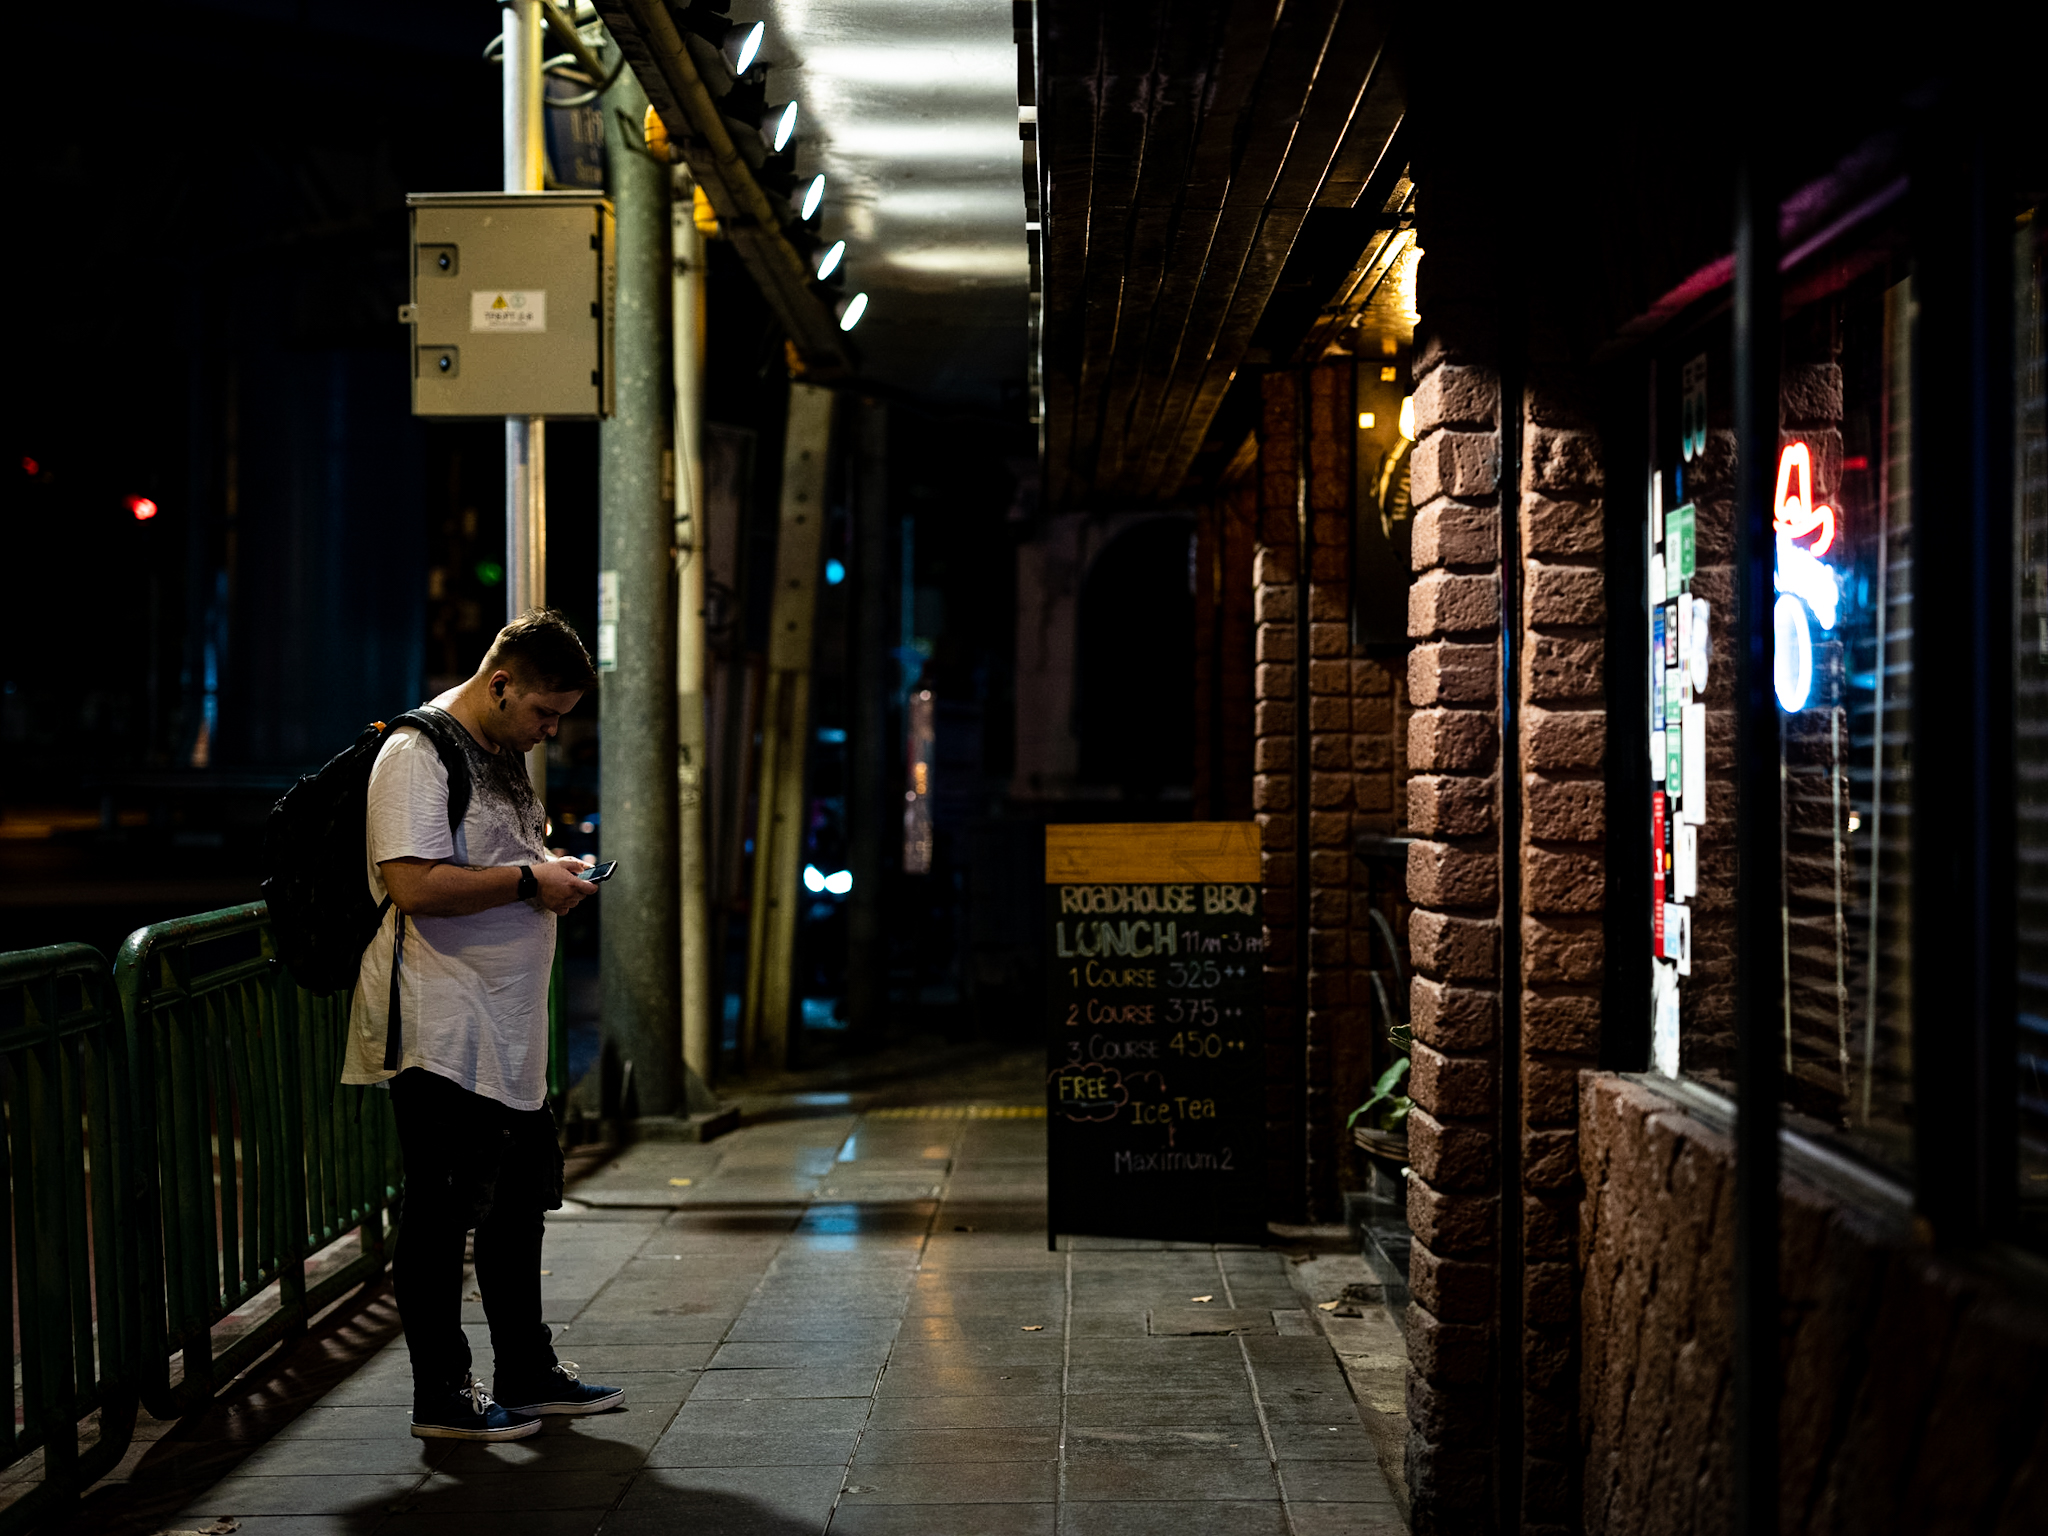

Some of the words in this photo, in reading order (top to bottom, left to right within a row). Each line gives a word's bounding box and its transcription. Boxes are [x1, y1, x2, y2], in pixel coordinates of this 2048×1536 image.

[1202, 884, 1258, 916] BBQ
[1056, 919, 1178, 958] LUNCH
[1068, 966, 1079, 989] 1
[1065, 1003, 1080, 1026] 2
[1066, 1041, 1084, 1064] 3
[1058, 1075, 1109, 1100] FREE
[1130, 1101, 1173, 1126] Ice
[1173, 1096, 1217, 1121] Tea
